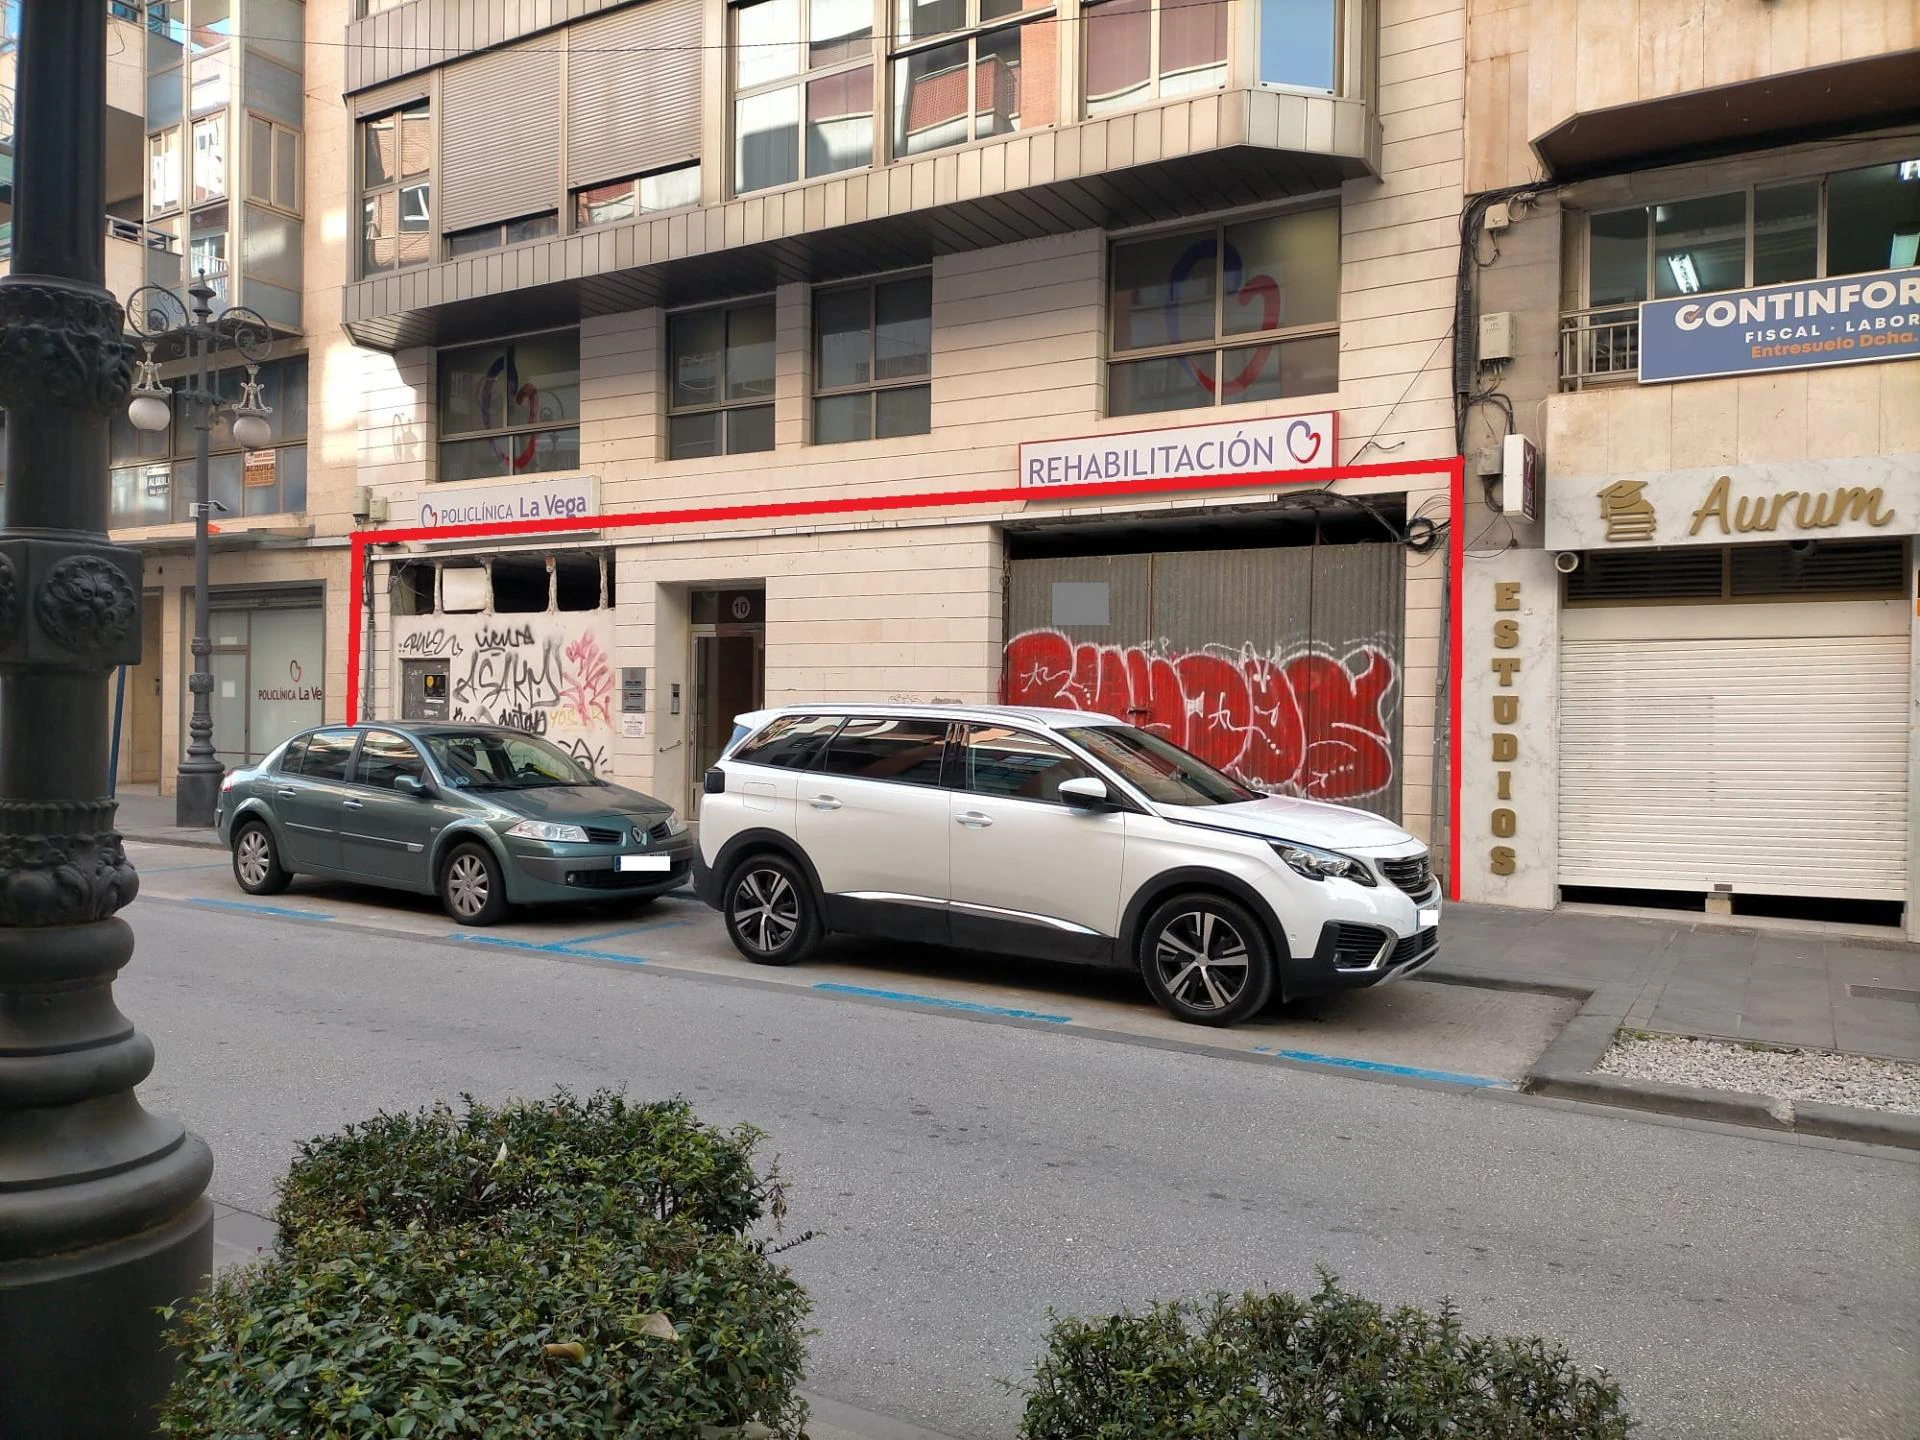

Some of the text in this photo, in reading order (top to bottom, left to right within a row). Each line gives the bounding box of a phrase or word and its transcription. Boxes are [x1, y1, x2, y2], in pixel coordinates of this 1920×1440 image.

[1675, 277, 1920, 331] CONTINFOR
[1745, 313, 1920, 344] FISCAL LABOR
[1751, 331, 1919, 359] Entresuelo Dcha.
[1028, 431, 1274, 485] REHABILITACIÓN
[441, 494, 587, 524] POLICLÍNICA La Vega
[1689, 475, 1895, 536] Aurum
[734, 601, 749, 615] 10
[258, 686, 322, 700] POLICLÍNICA La Ve
[1490, 582, 1521, 876] ESTUDIOS
